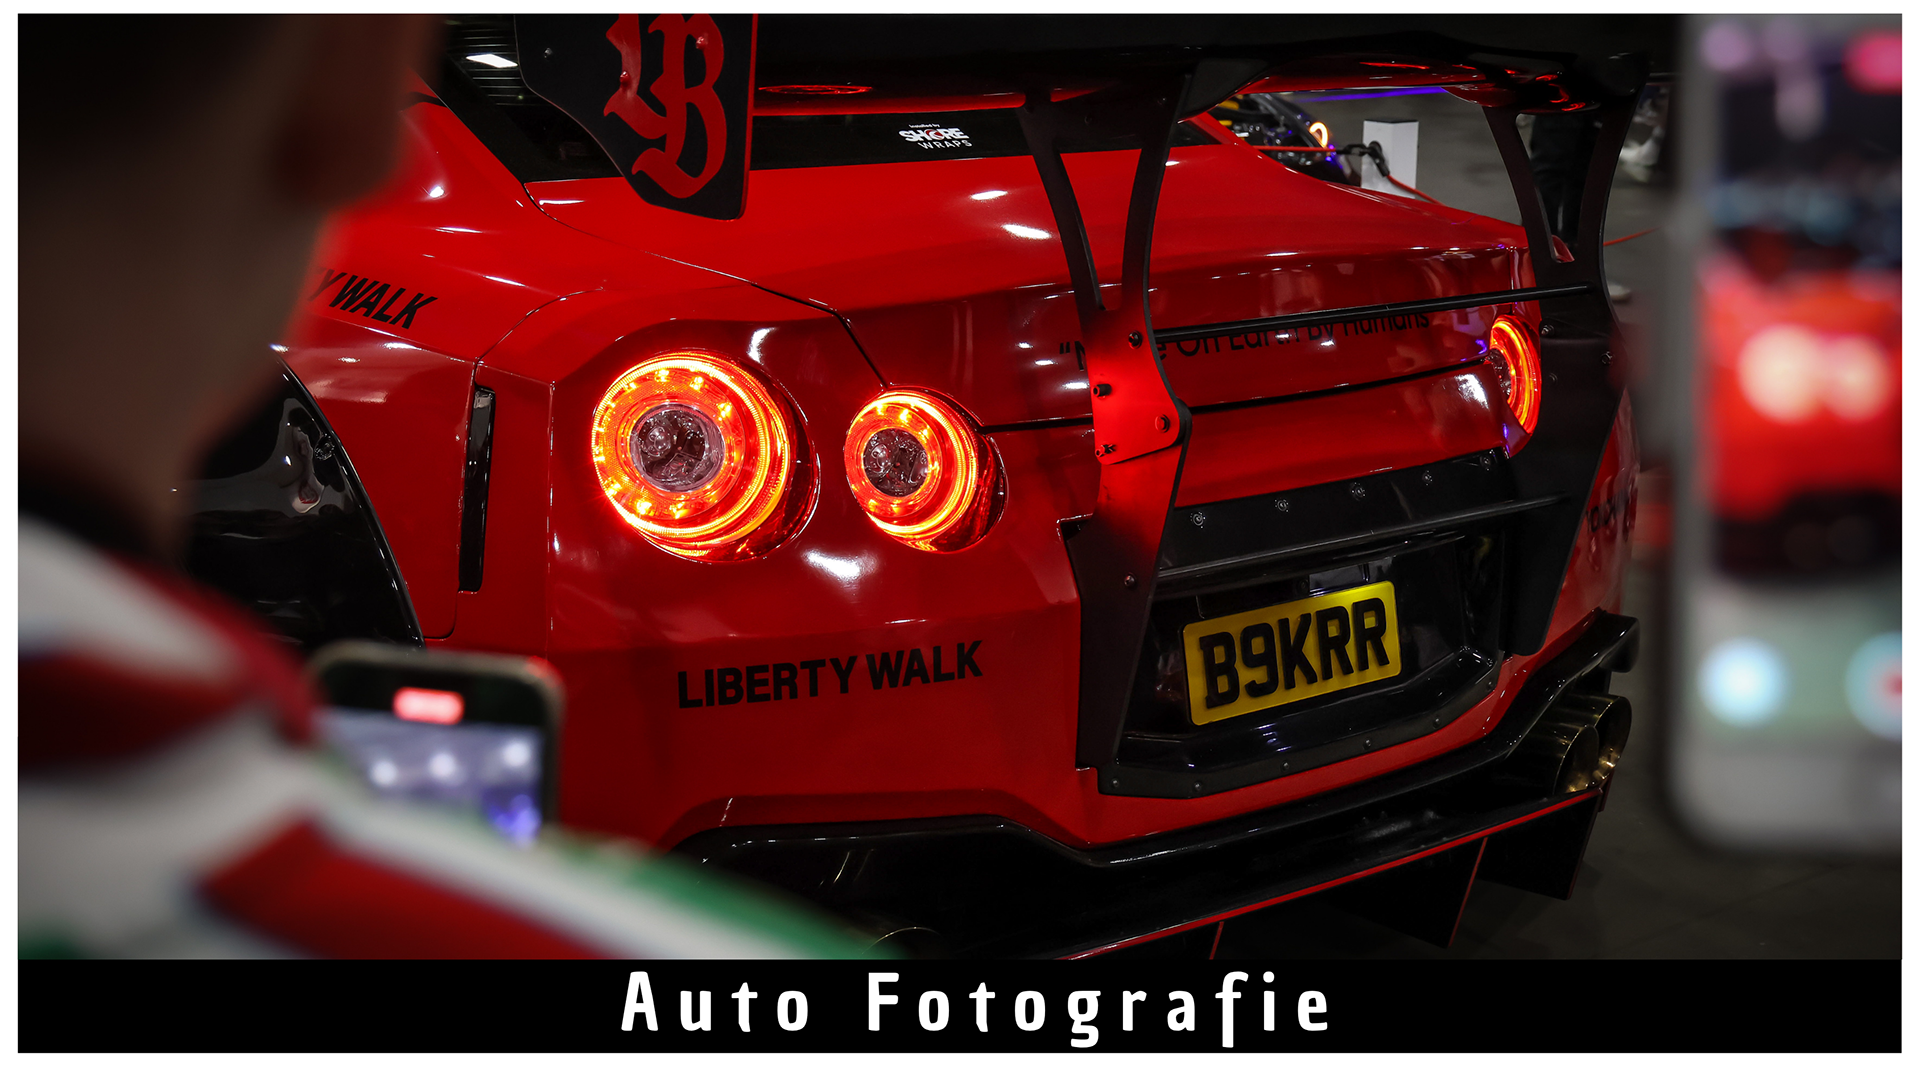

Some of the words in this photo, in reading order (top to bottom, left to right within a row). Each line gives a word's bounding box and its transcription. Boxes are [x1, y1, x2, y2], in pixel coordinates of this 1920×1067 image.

[899, 128, 969, 142] SHORE
[917, 140, 973, 149] WRAPS
[328, 274, 439, 330] WALK
[678, 656, 858, 709] LIBERTY
[865, 640, 984, 691] WALK
[1199, 598, 1390, 709] B9KRR
